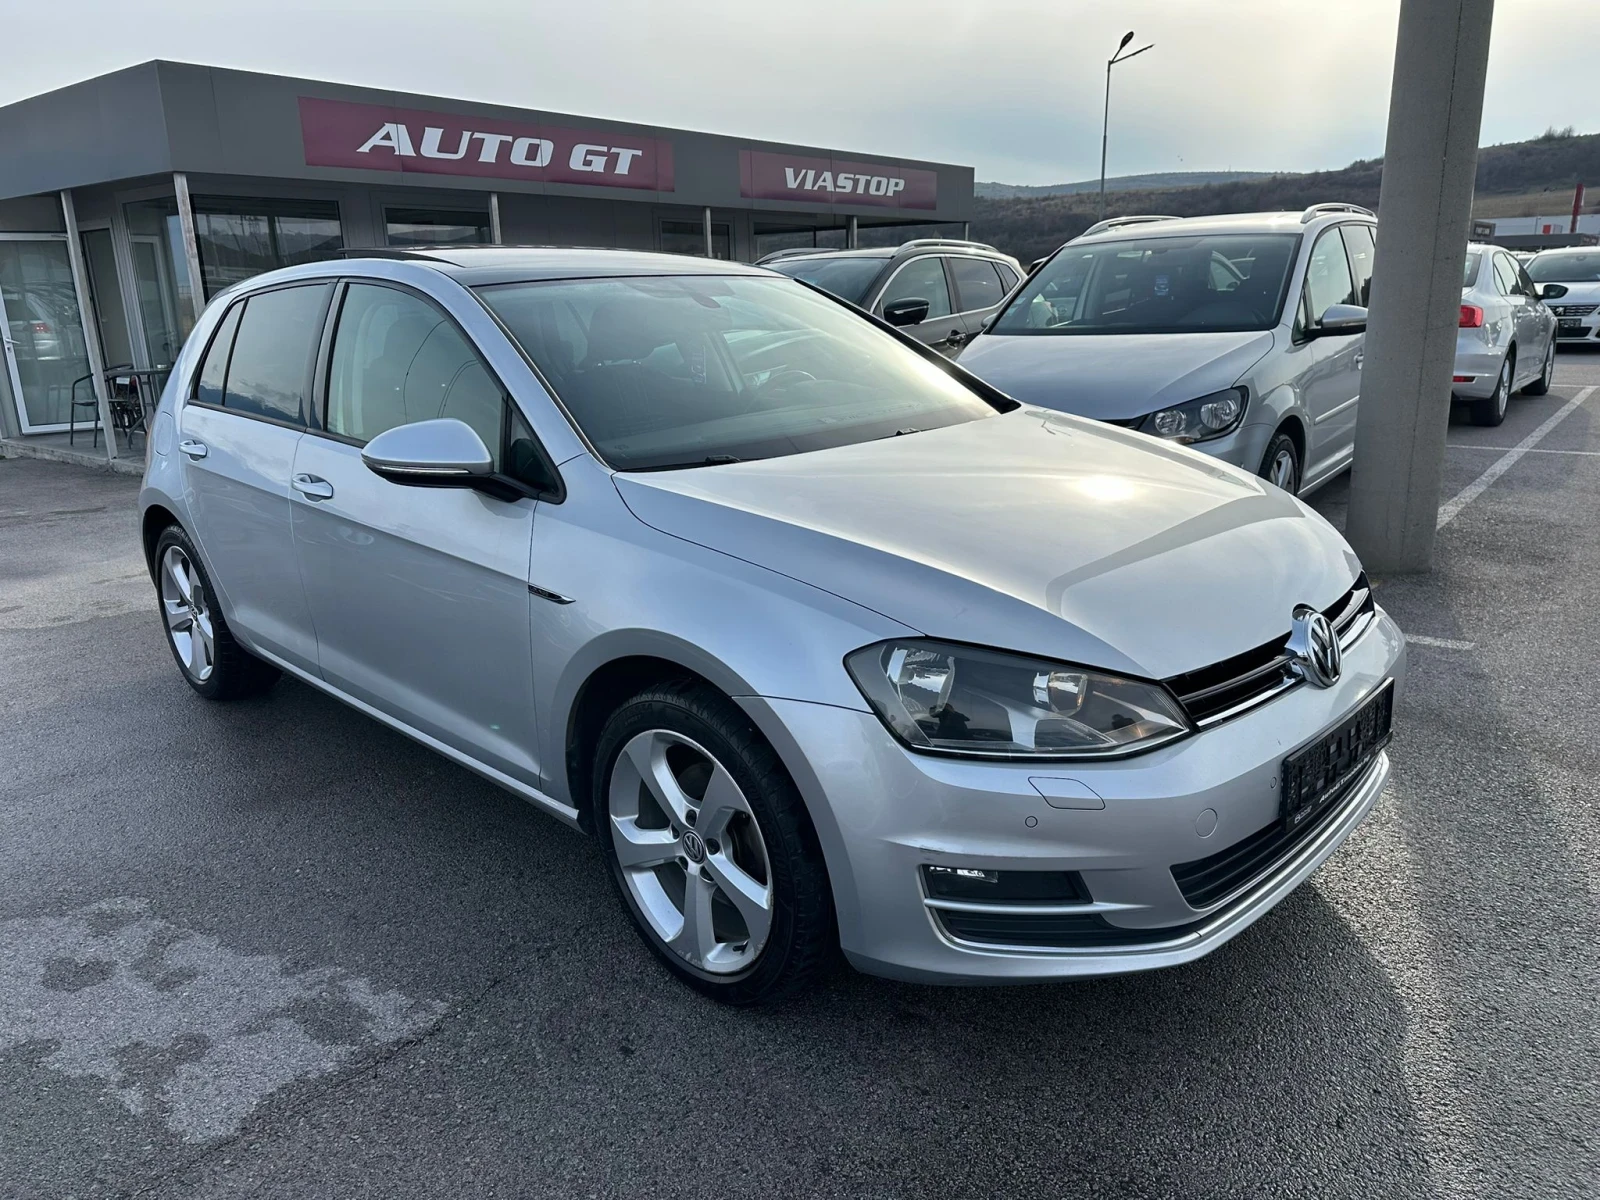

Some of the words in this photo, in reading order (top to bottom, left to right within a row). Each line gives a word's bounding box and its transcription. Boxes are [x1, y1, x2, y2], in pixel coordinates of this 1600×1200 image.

[357, 123, 555, 167] AUTO
[568, 144, 642, 176] GT
[784, 167, 906, 197] VIASTOP
